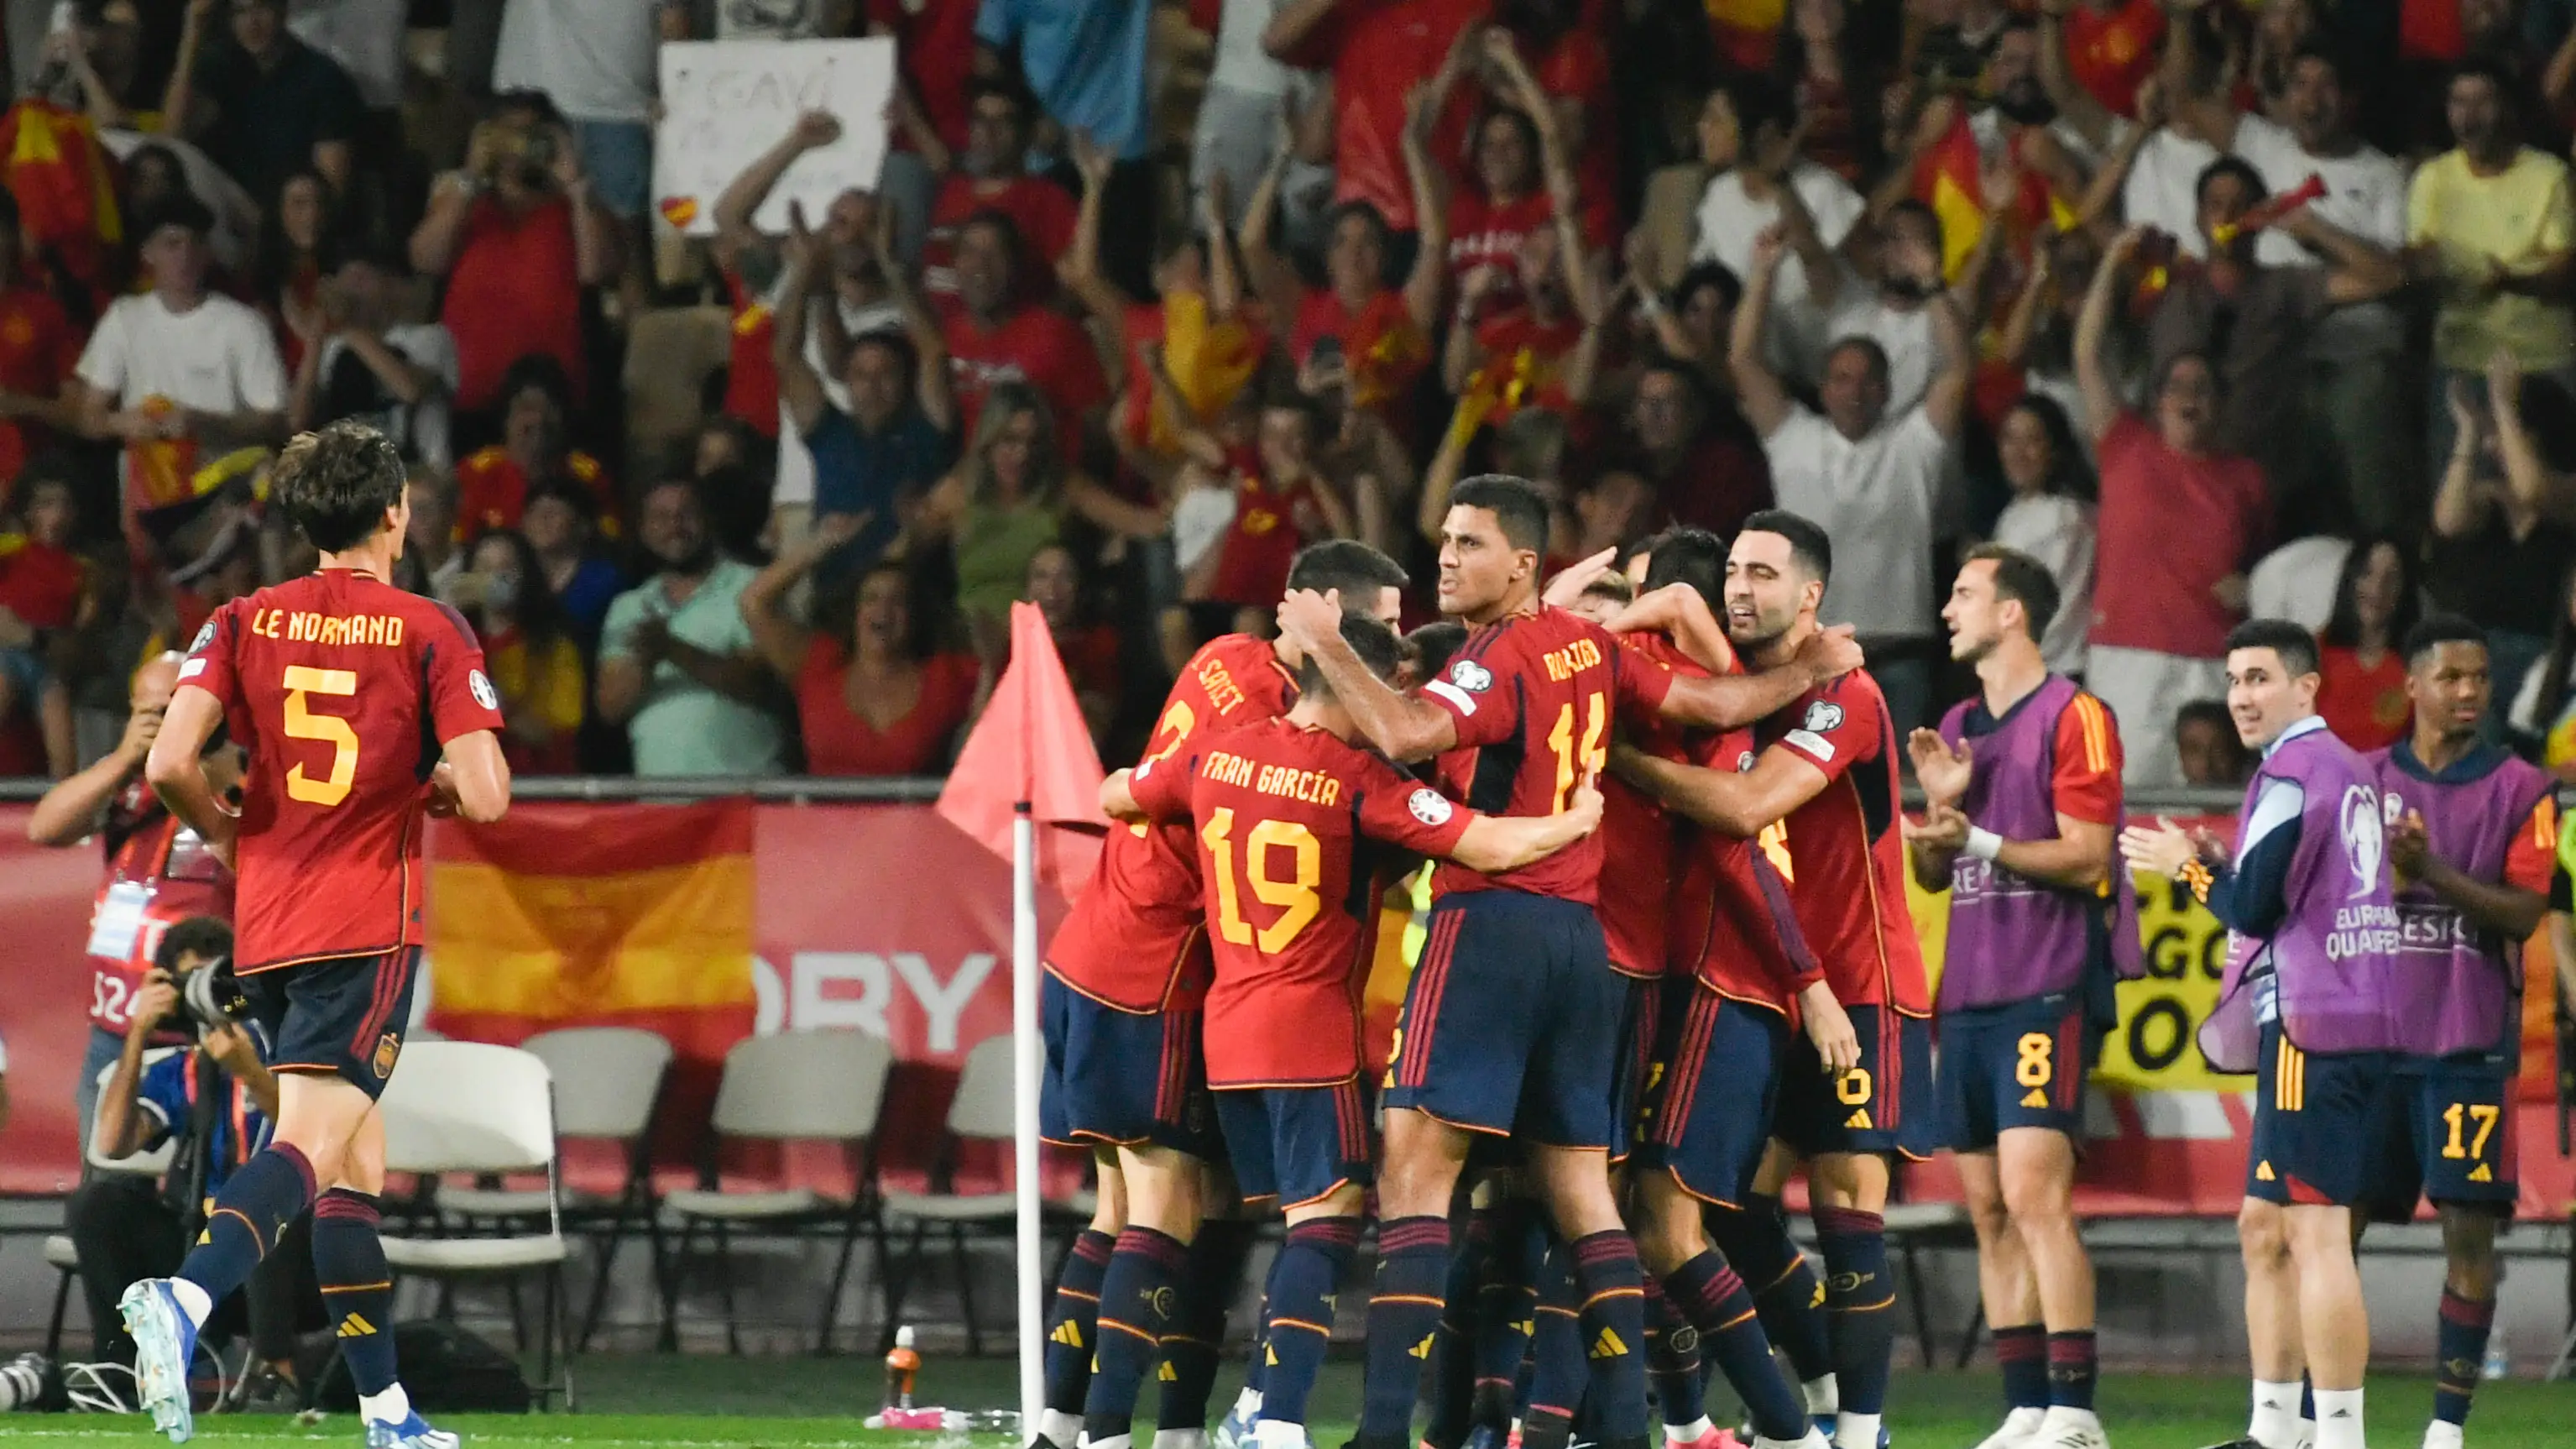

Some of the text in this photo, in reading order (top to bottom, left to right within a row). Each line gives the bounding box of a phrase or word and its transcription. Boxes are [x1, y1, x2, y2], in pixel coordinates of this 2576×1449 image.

[252, 607, 405, 647] LE NORMAND
[282, 664, 359, 808] 5
[1201, 751, 1340, 807] FRAN GARCÍA
[1200, 806, 1321, 955] 19
[2015, 1032, 2053, 1088] 8
[2442, 1102, 2500, 1160] 17
